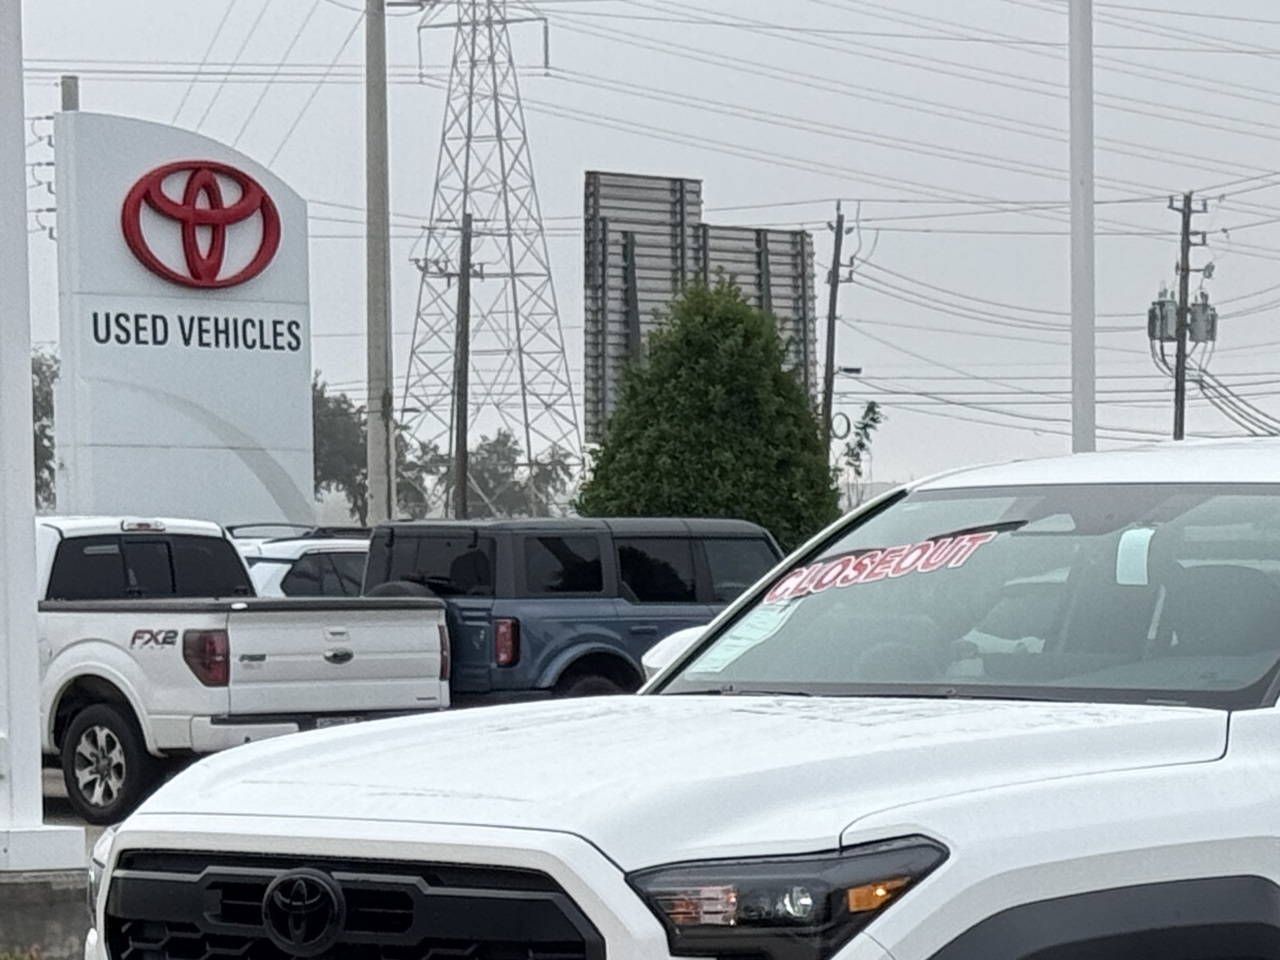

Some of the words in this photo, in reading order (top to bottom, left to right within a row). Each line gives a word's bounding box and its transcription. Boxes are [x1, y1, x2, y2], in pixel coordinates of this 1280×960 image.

[92, 311, 169, 346] USED
[177, 314, 302, 351] VEHICLES
[763, 530, 999, 604] CLOSEOUT
[131, 629, 179, 646] FX2
